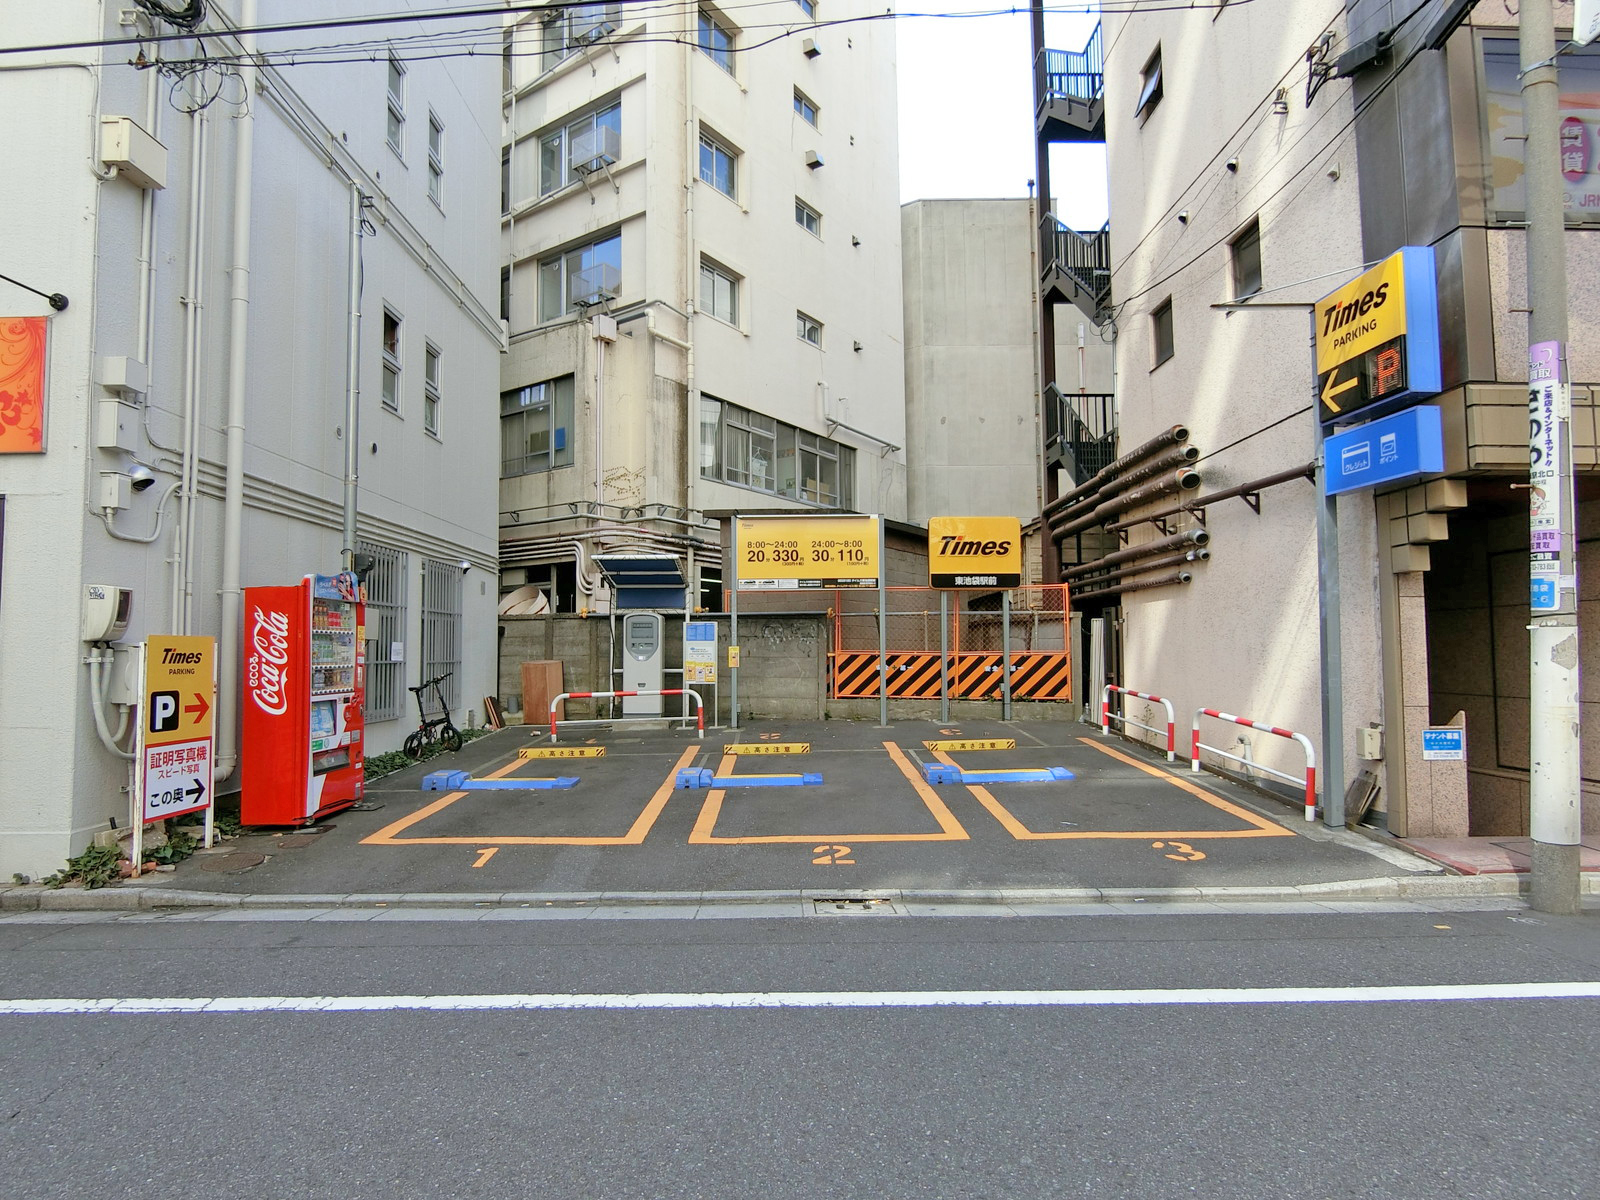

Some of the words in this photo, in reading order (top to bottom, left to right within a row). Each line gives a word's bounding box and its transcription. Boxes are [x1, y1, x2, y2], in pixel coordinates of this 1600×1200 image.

[1562, 126, 1584, 173] 賃貸
[1322, 282, 1389, 337] Times
[1333, 319, 1377, 350] PARKING
[1377, 348, 1400, 395] P
[1345, 460, 1368, 471] クレジット
[1380, 455, 1399, 464] ポイント
[940, 535, 1011, 556] Times
[954, 576, 997, 586] 東池袋駅前
[162, 648, 203, 665] Times
[253, 604, 289, 715] Coca-Cola
[155, 695, 176, 730] P
[754, 746, 791, 754] 高さ注意
[959, 742, 997, 750] 高さ注意
[150, 745, 207, 770] 証明写真機
[158, 763, 200, 780] スピード写真
[150, 787, 184, 808] この奥
[471, 847, 500, 868] 1
[812, 844, 856, 865] 2
[1151, 840, 1207, 861] 3
